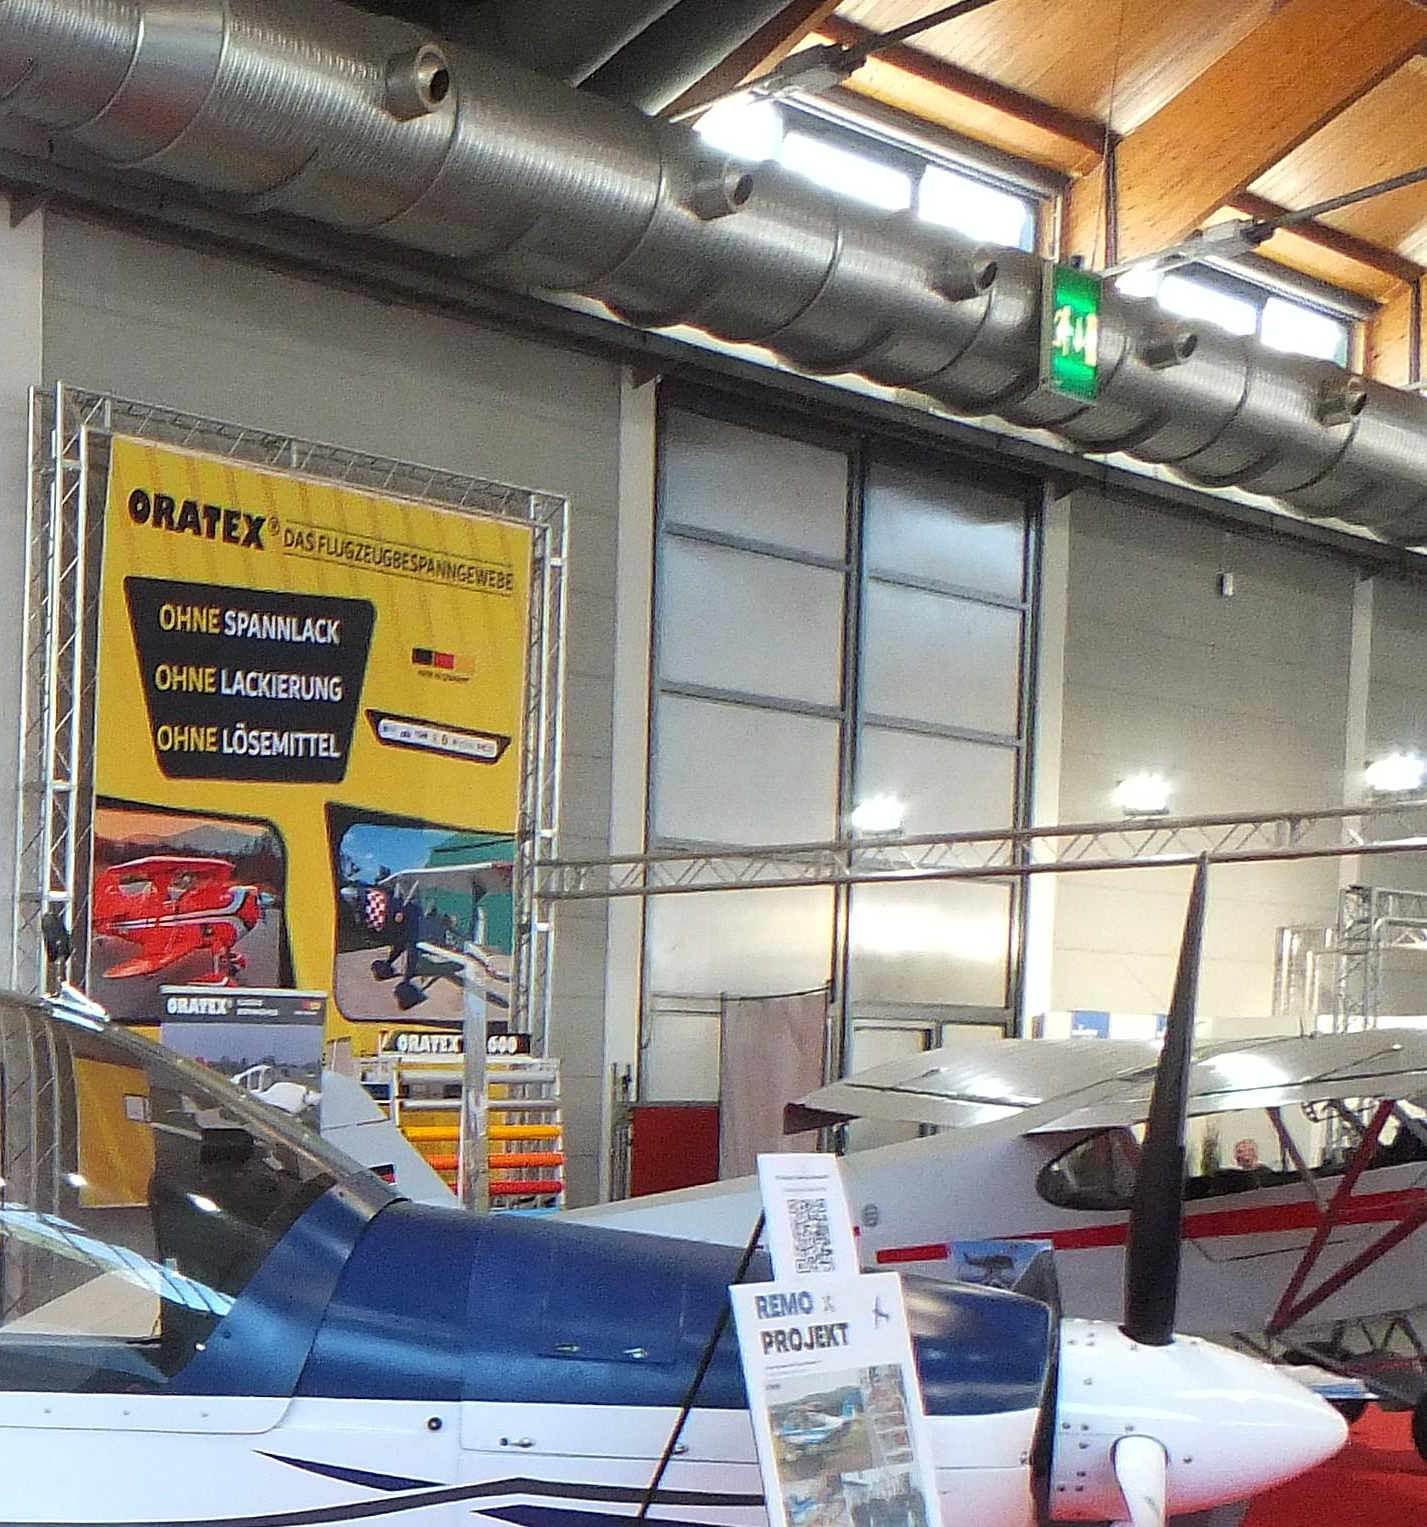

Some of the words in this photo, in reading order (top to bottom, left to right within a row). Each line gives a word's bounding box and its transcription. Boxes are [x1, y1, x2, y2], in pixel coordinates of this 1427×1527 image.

[283, 529, 314, 553] DAS
[317, 532, 516, 592] FLUGZEUGBESPANNGEWEBE
[159, 602, 221, 637] OHNE
[223, 608, 340, 646] SPANNLACK
[154, 662, 217, 696] OHNE
[220, 672, 343, 702] LACKIERUNG
[156, 724, 218, 753] OHNE
[221, 722, 341, 760] LÖSEMITTEL
[754, 1290, 814, 1320] REMO
[760, 1321, 849, 1355] PROJEKT
